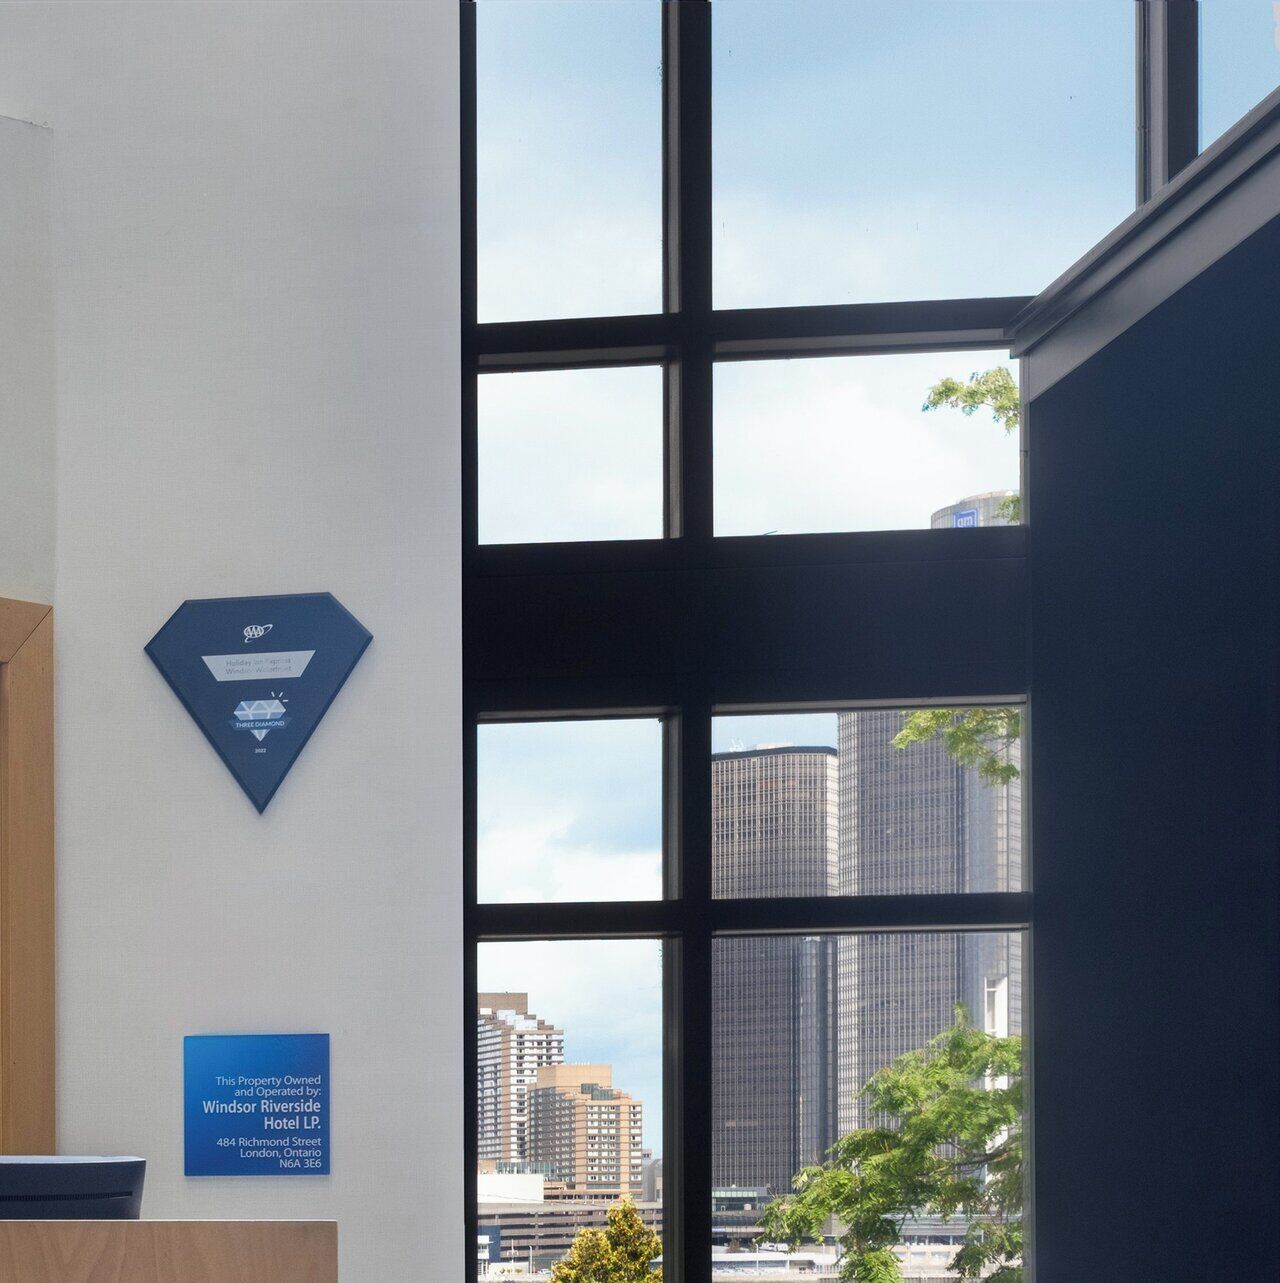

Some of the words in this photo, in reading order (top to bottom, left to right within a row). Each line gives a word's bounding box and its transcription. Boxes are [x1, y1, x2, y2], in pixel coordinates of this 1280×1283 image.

[244, 625, 264, 638] AAA
[254, 720, 285, 728] DIAMOND
[215, 1076, 236, 1086] This
[238, 1076, 281, 1087] Property
[283, 1075, 322, 1085] Owned
[234, 1087, 254, 1097] and
[256, 1086, 304, 1098] Operated
[306, 1086, 322, 1097] by:
[202, 1100, 257, 1114] Windsor
[260, 1099, 321, 1113] Riverside
[264, 1116, 300, 1130] Hotel
[303, 1115, 321, 1129] LP.
[216, 1138, 236, 1147] 484
[238, 1137, 290, 1147] Richmond
[292, 1137, 322, 1147] Street
[240, 1148, 282, 1159] London,
[283, 1148, 322, 1158] Ontario
[279, 1159, 301, 1168] N6A
[303, 1158, 322, 1168] 3E6
